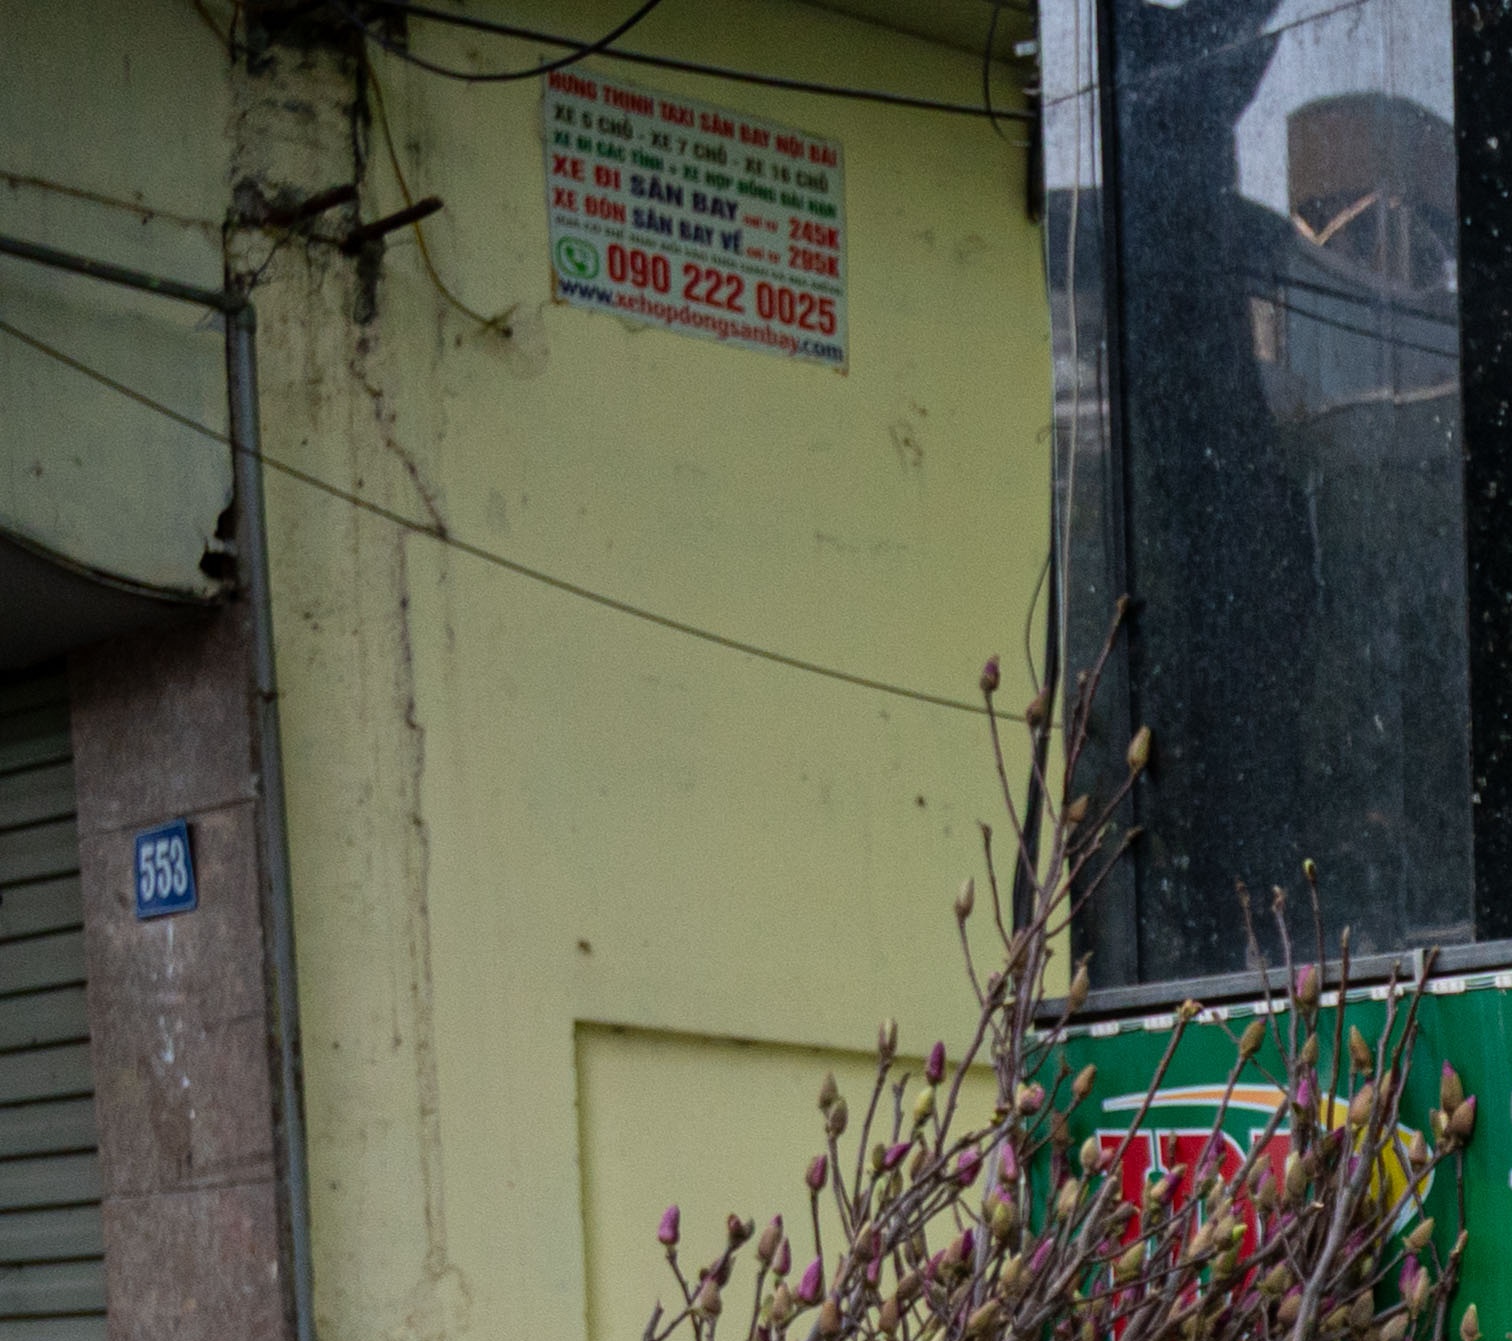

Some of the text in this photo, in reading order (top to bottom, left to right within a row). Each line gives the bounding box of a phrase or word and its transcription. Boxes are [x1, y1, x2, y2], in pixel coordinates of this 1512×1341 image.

[553, 105, 574, 126] XE
[651, 131, 673, 153] XE
[745, 156, 763, 175] XE
[660, 100, 695, 127] TAXI
[700, 112, 735, 139] SÂN
[740, 123, 770, 148] BAY
[809, 142, 837, 168] BÀI
[553, 154, 585, 184] XE
[594, 164, 621, 191] ĐI
[630, 173, 684, 207] SÂN
[692, 191, 738, 221] BAY
[788, 216, 839, 249] 245K
[553, 187, 578, 212] XE
[584, 193, 626, 224] ĐÓN
[632, 206, 673, 237] SÂN
[679, 219, 715, 247] BAY
[558, 277, 844, 362] www.xehopdongsanbay.com
[607, 243, 671, 294] 090
[682, 262, 745, 314] 222
[755, 281, 837, 337] 0025
[139, 835, 189, 902] 553
